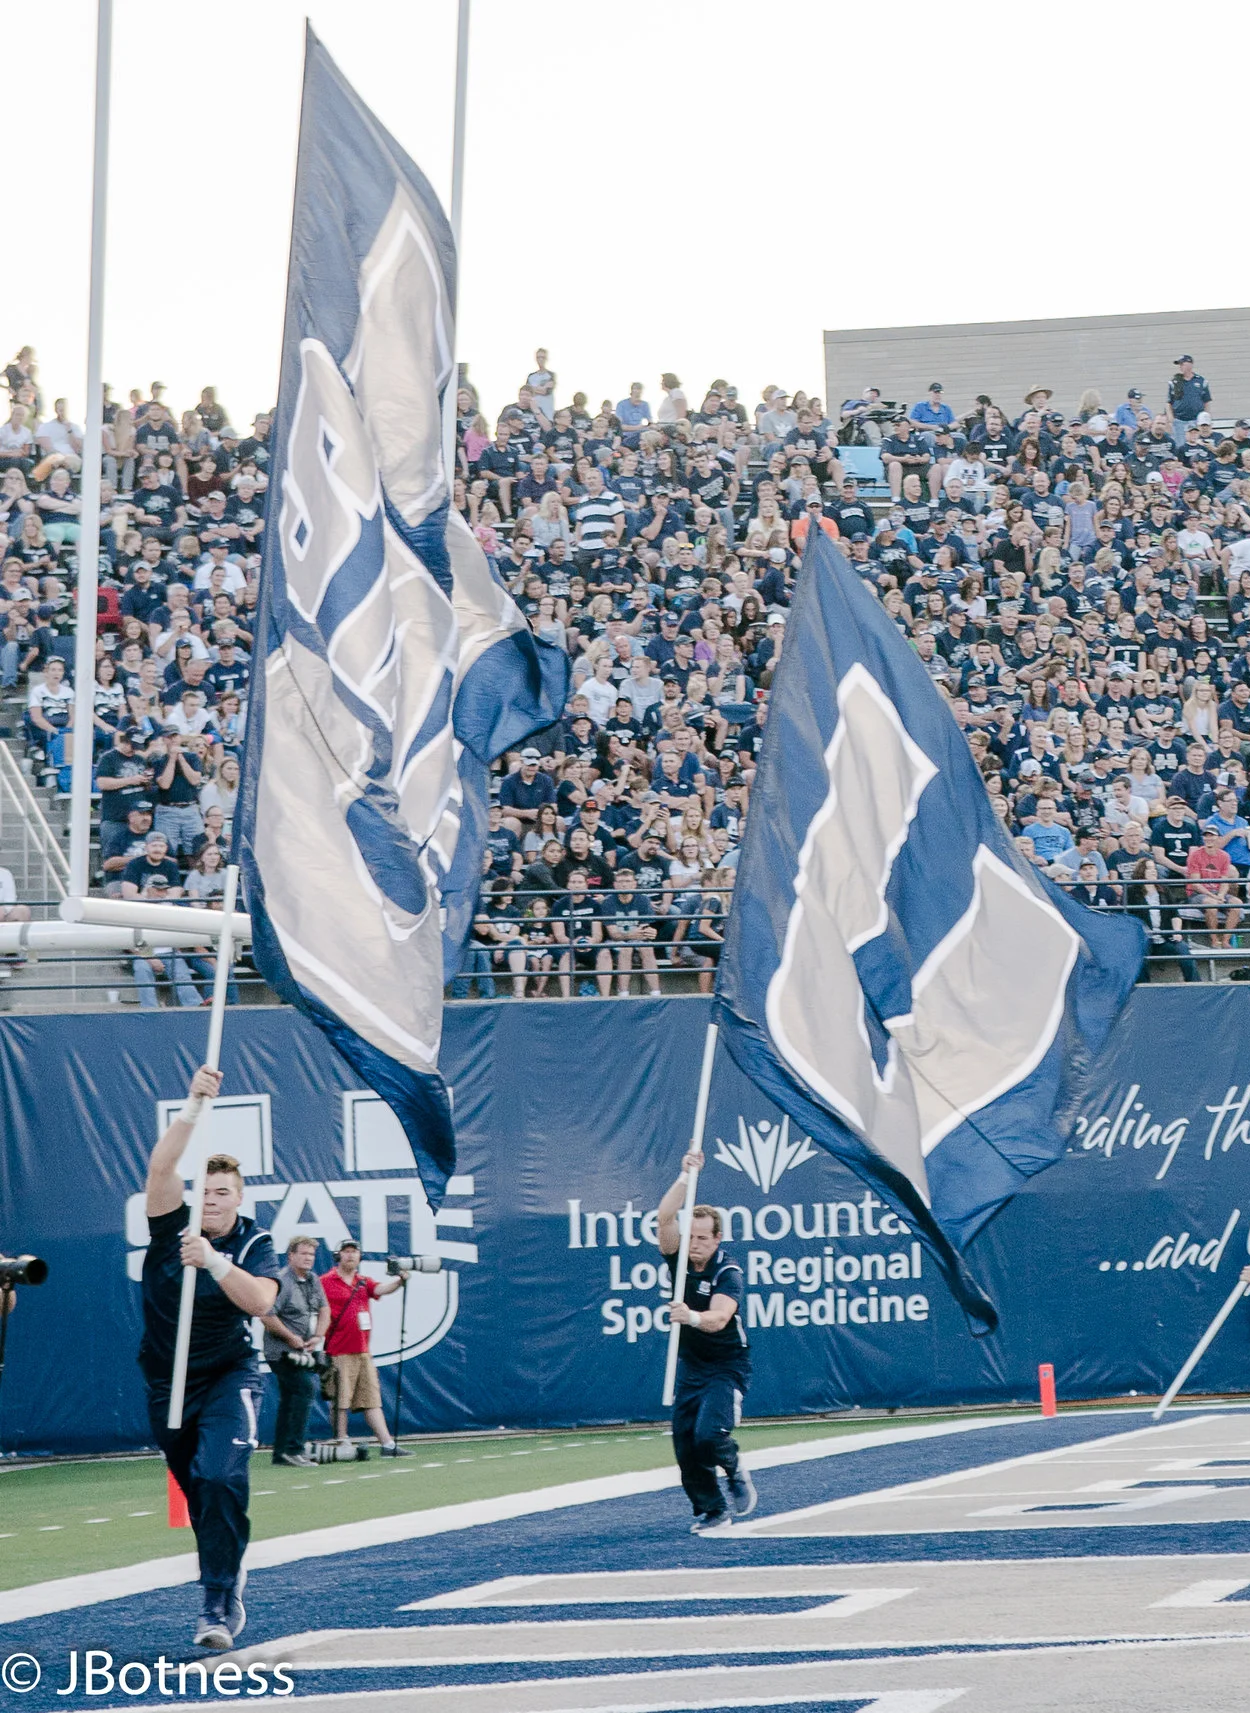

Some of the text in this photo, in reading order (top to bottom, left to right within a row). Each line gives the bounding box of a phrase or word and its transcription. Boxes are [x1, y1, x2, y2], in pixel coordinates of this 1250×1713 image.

[1067, 1084, 1190, 1180] aling
[567, 1190, 914, 1249] Intemounta
[609, 1241, 922, 1300] Log Regional
[602, 1298, 673, 1344] Spo
[747, 1286, 930, 1329] Medicine
